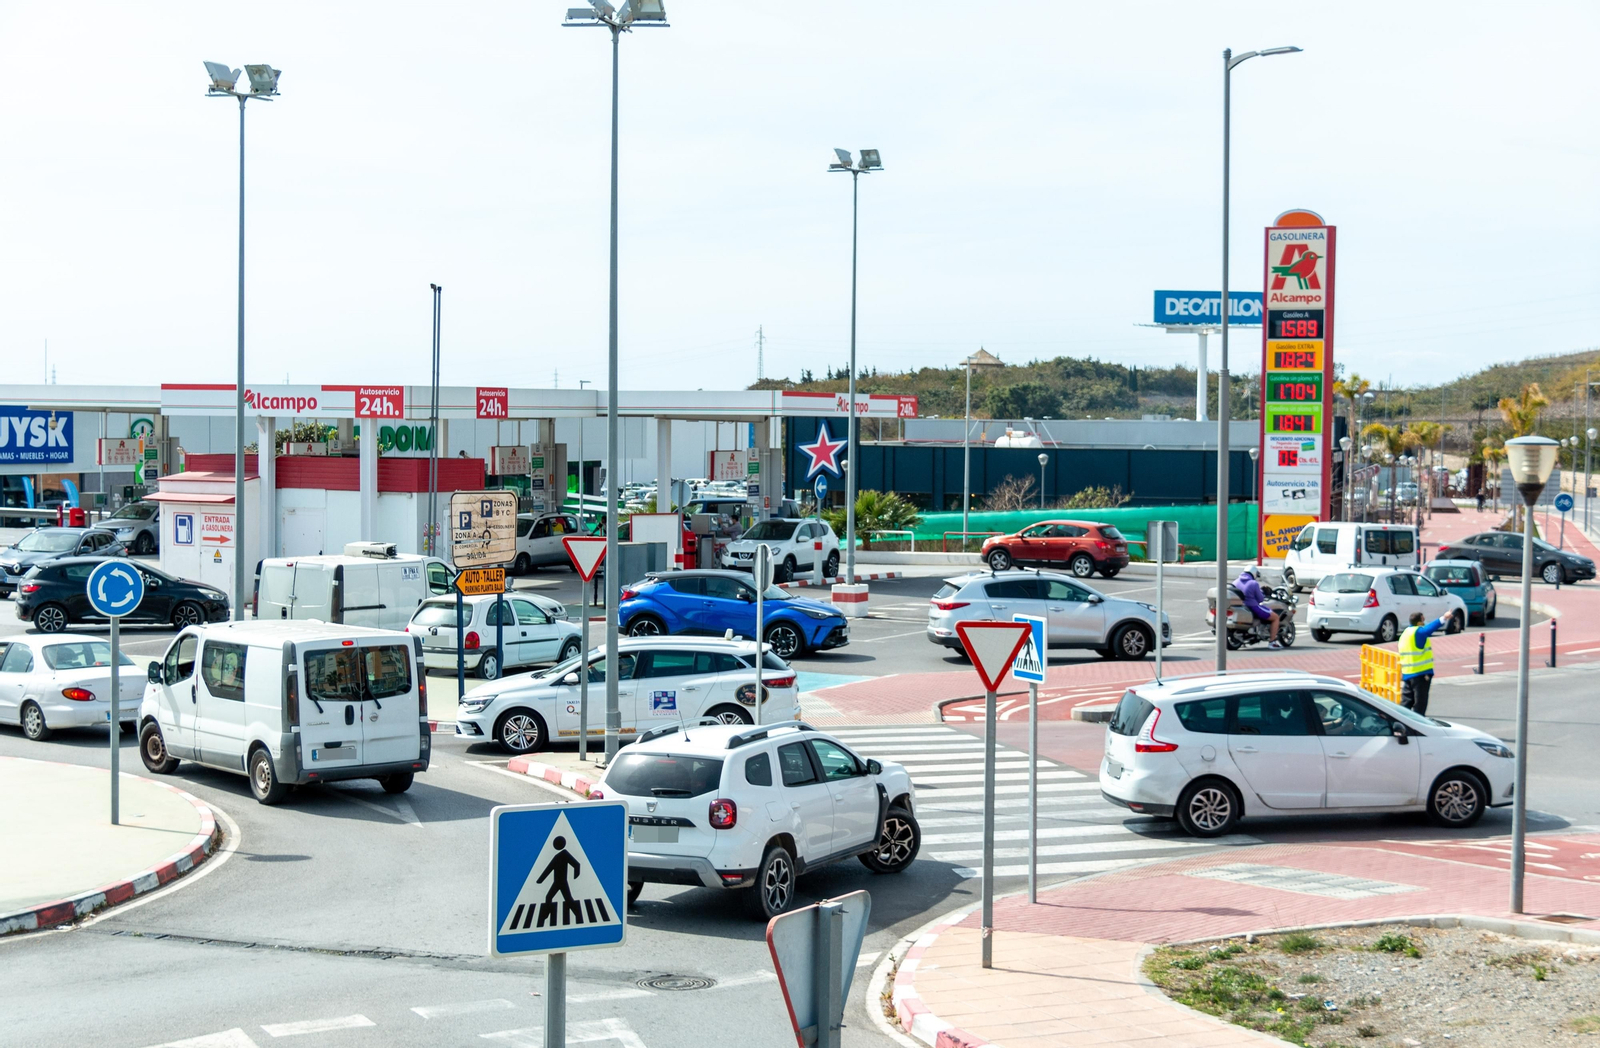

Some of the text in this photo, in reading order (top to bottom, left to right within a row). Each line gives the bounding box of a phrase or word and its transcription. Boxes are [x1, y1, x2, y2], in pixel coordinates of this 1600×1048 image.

[1270, 232, 1325, 241] GASOLINERA
[1270, 292, 1322, 304] Alcampo
[1282, 311, 1303, 319] Gasóleo
[479, 389, 506, 397] Autoservicio
[244, 389, 318, 413] Alcampo
[360, 396, 400, 416] 24h.
[479, 397, 506, 416] 24h.
[836, 396, 868, 414] Alcmpo
[20, 452, 45, 460] MUEBLES
[1278, 450, 1298, 467] 05
[1267, 480, 1305, 488] Autoservicio
[483, 502, 491, 516] P
[204, 515, 231, 524] ENTRADA
[461, 513, 470, 528] P
[206, 524, 234, 533] GASOLINERA
[467, 551, 487, 560] SALIDA
[465, 569, 504, 583] AUTO TALLER
[464, 584, 503, 594] PARKING PLANTA BAJA
